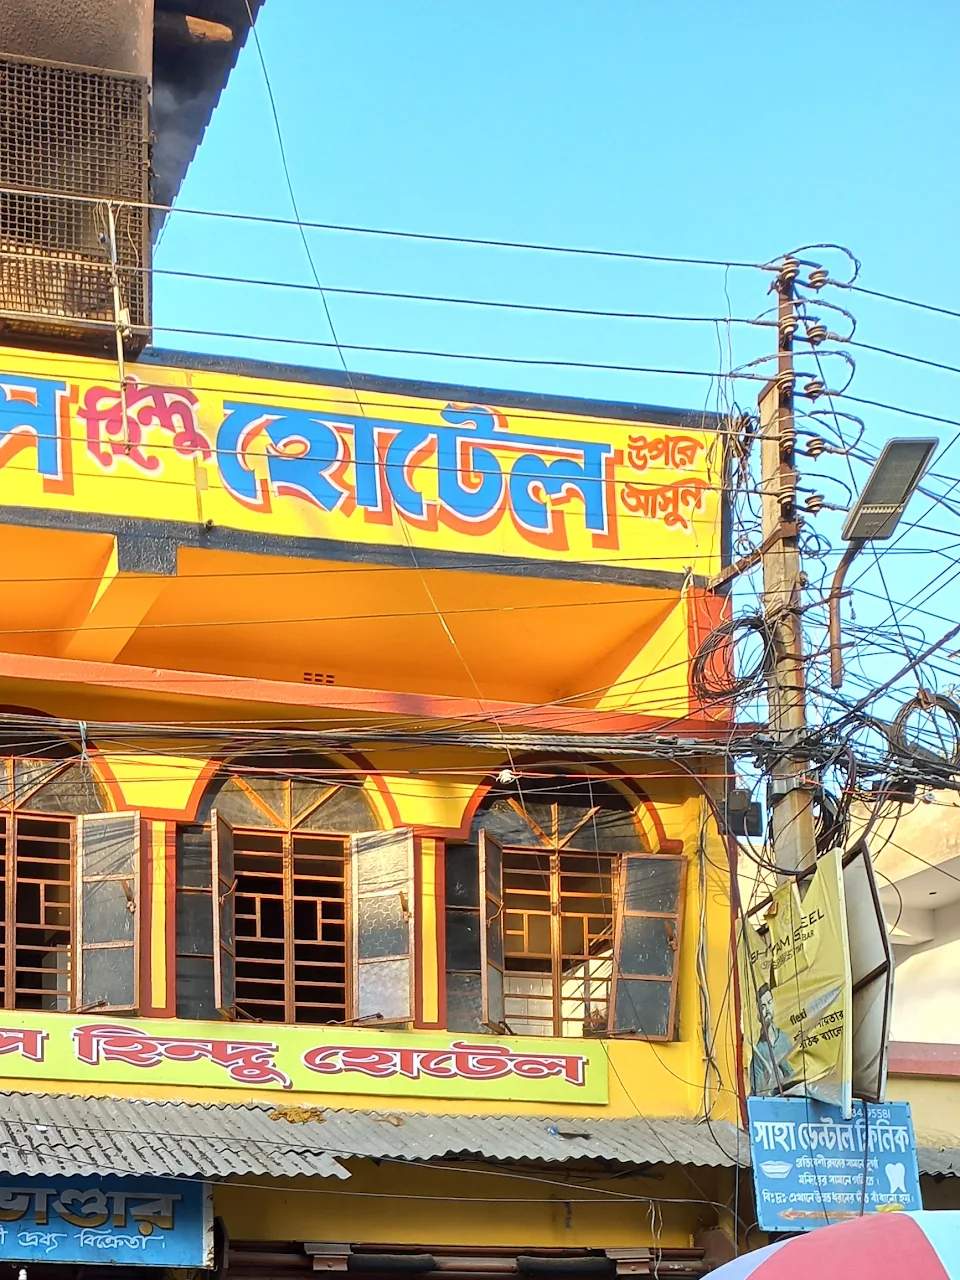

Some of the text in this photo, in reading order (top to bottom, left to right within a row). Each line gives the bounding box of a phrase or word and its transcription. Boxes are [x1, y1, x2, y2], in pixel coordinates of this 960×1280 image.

[77, 376, 210, 471] হিন্দু
[217, 402, 623, 550] হোটেল
[627, 434, 702, 469] উপরে
[621, 478, 705, 529] আসুন
[72, 1024, 293, 1089] হিন্দু
[302, 1041, 589, 1086] হোটেল
[754, 1121, 797, 1152] সাহা
